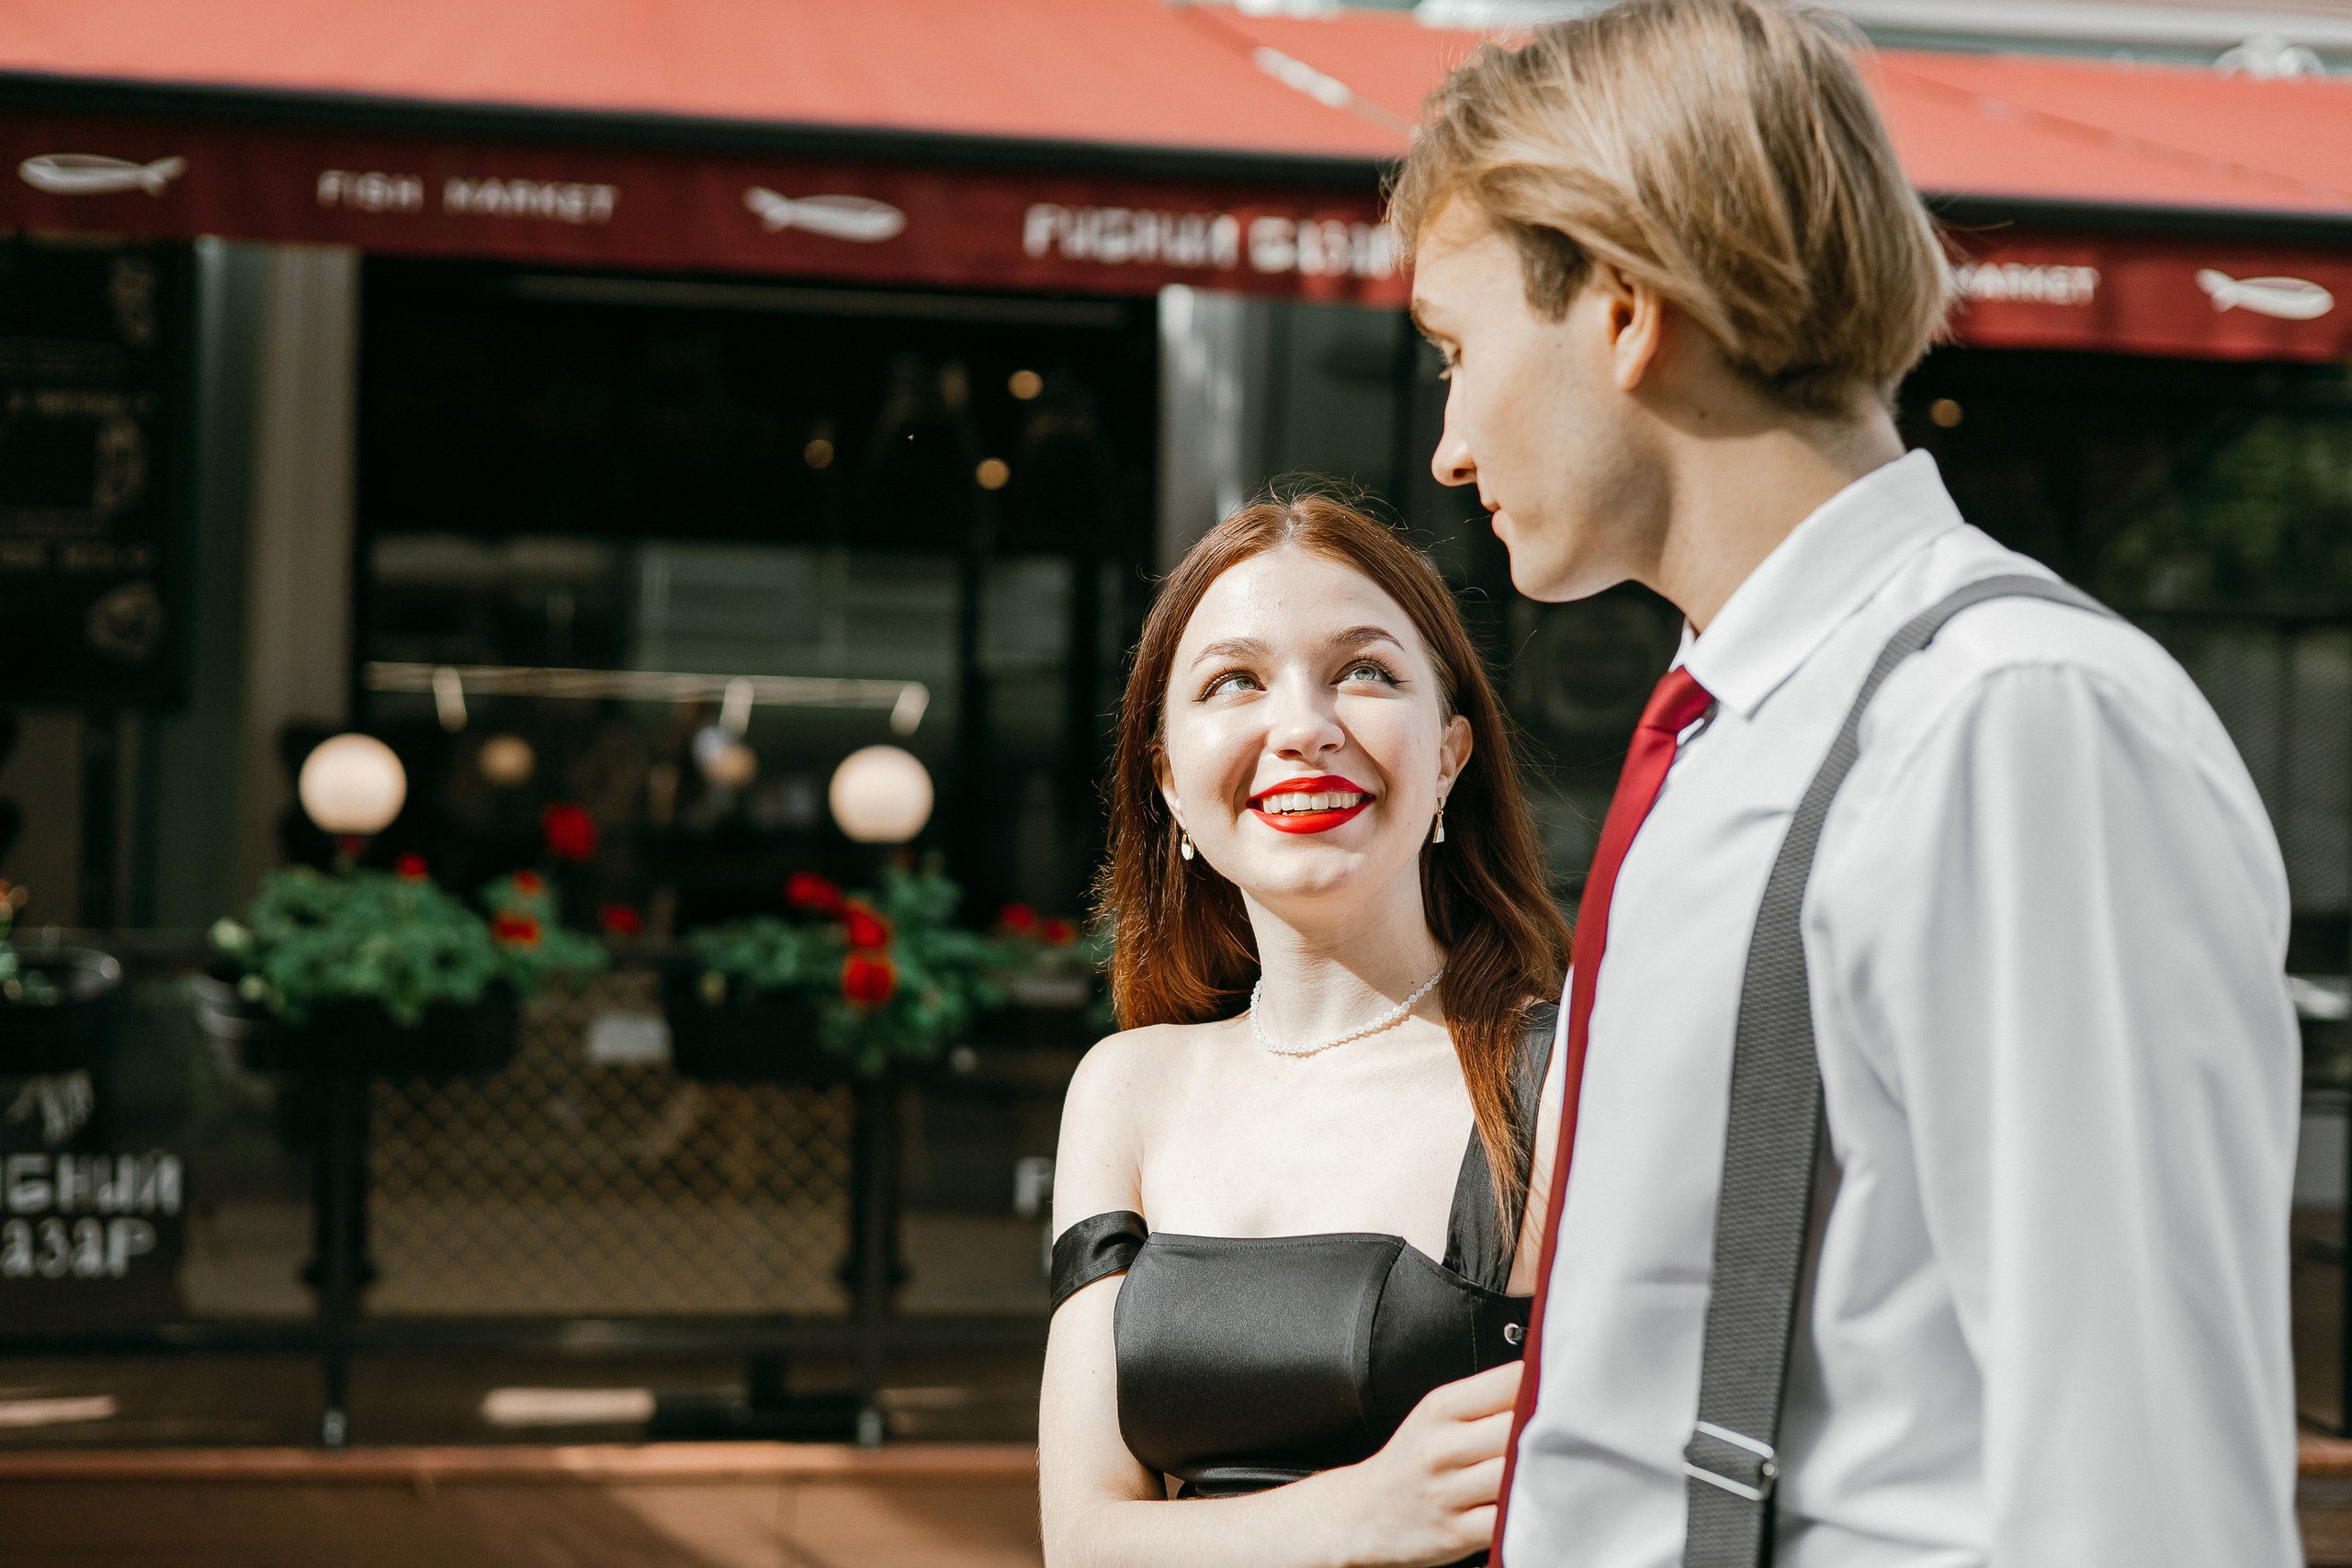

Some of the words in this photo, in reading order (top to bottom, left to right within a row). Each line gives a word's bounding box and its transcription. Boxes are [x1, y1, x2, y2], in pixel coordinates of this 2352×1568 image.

[316, 169, 424, 212] FISH
[442, 176, 620, 224] MARKET
[0, 1149, 184, 1217] БНЫЙ
